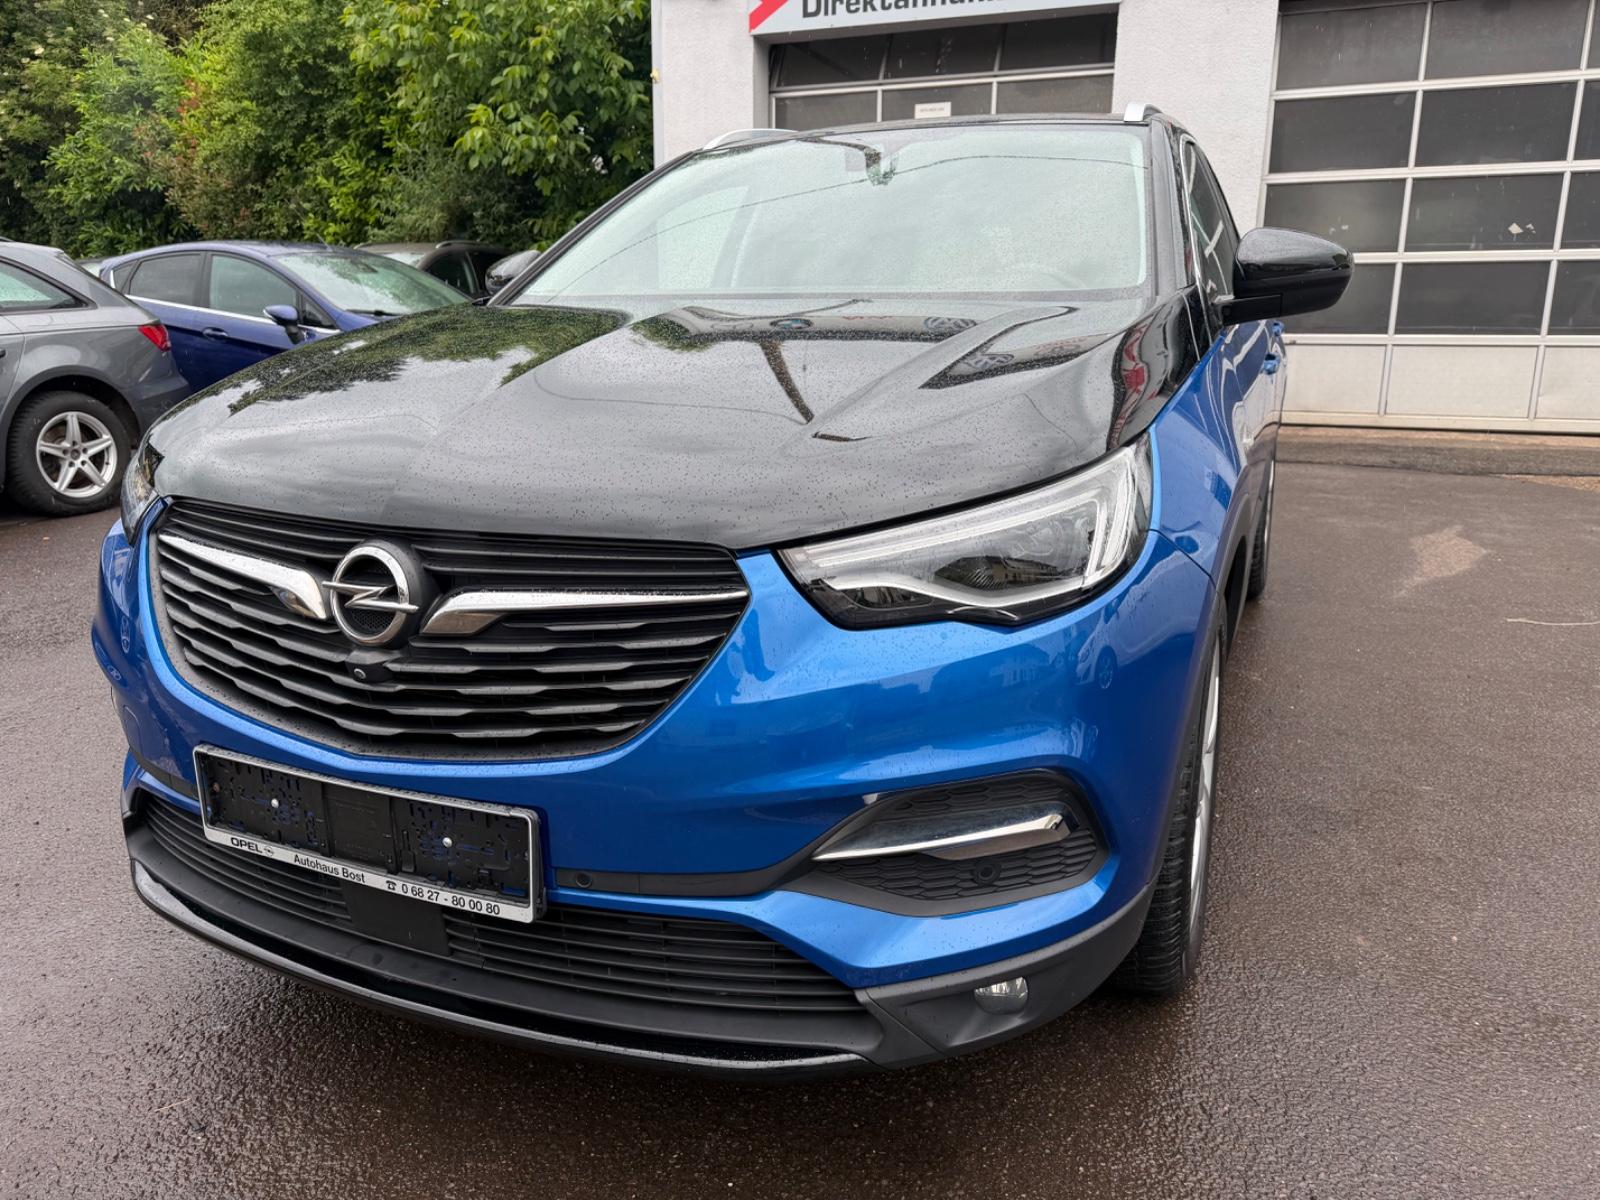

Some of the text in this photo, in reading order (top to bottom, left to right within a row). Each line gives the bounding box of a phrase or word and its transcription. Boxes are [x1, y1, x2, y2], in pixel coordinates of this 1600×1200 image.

[230, 837, 263, 854] OPEL
[293, 854, 366, 884] Autohaus Bost
[401, 883, 409, 895] 0
[410, 887, 425, 899] 68
[426, 889, 441, 902] 27
[451, 895, 466, 908] 80
[468, 899, 483, 912] 00
[485, 902, 501, 916] 80
